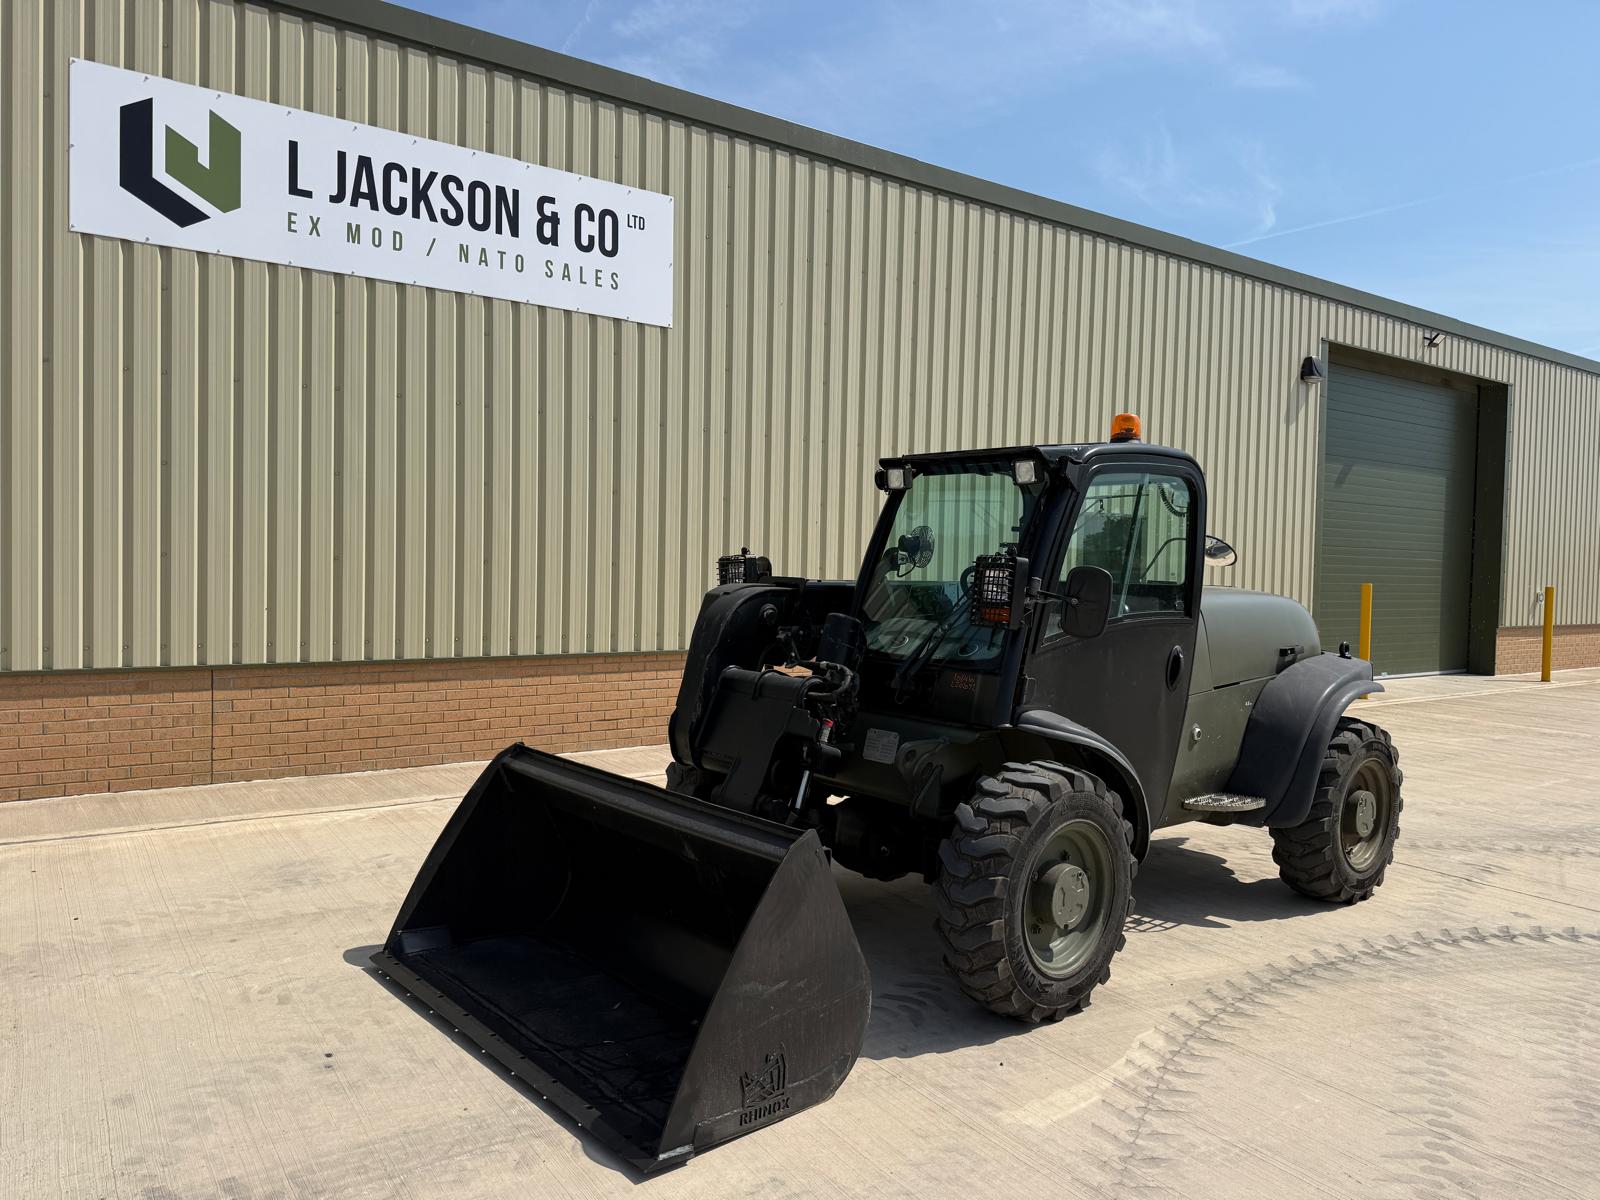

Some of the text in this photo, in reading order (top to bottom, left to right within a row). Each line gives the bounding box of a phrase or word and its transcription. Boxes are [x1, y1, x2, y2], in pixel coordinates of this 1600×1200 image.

[287, 139, 647, 259] L JACKSON & CO LTD
[287, 211, 620, 292] EX MOD / NATO SALES
[739, 1097, 790, 1126] RHINOX
